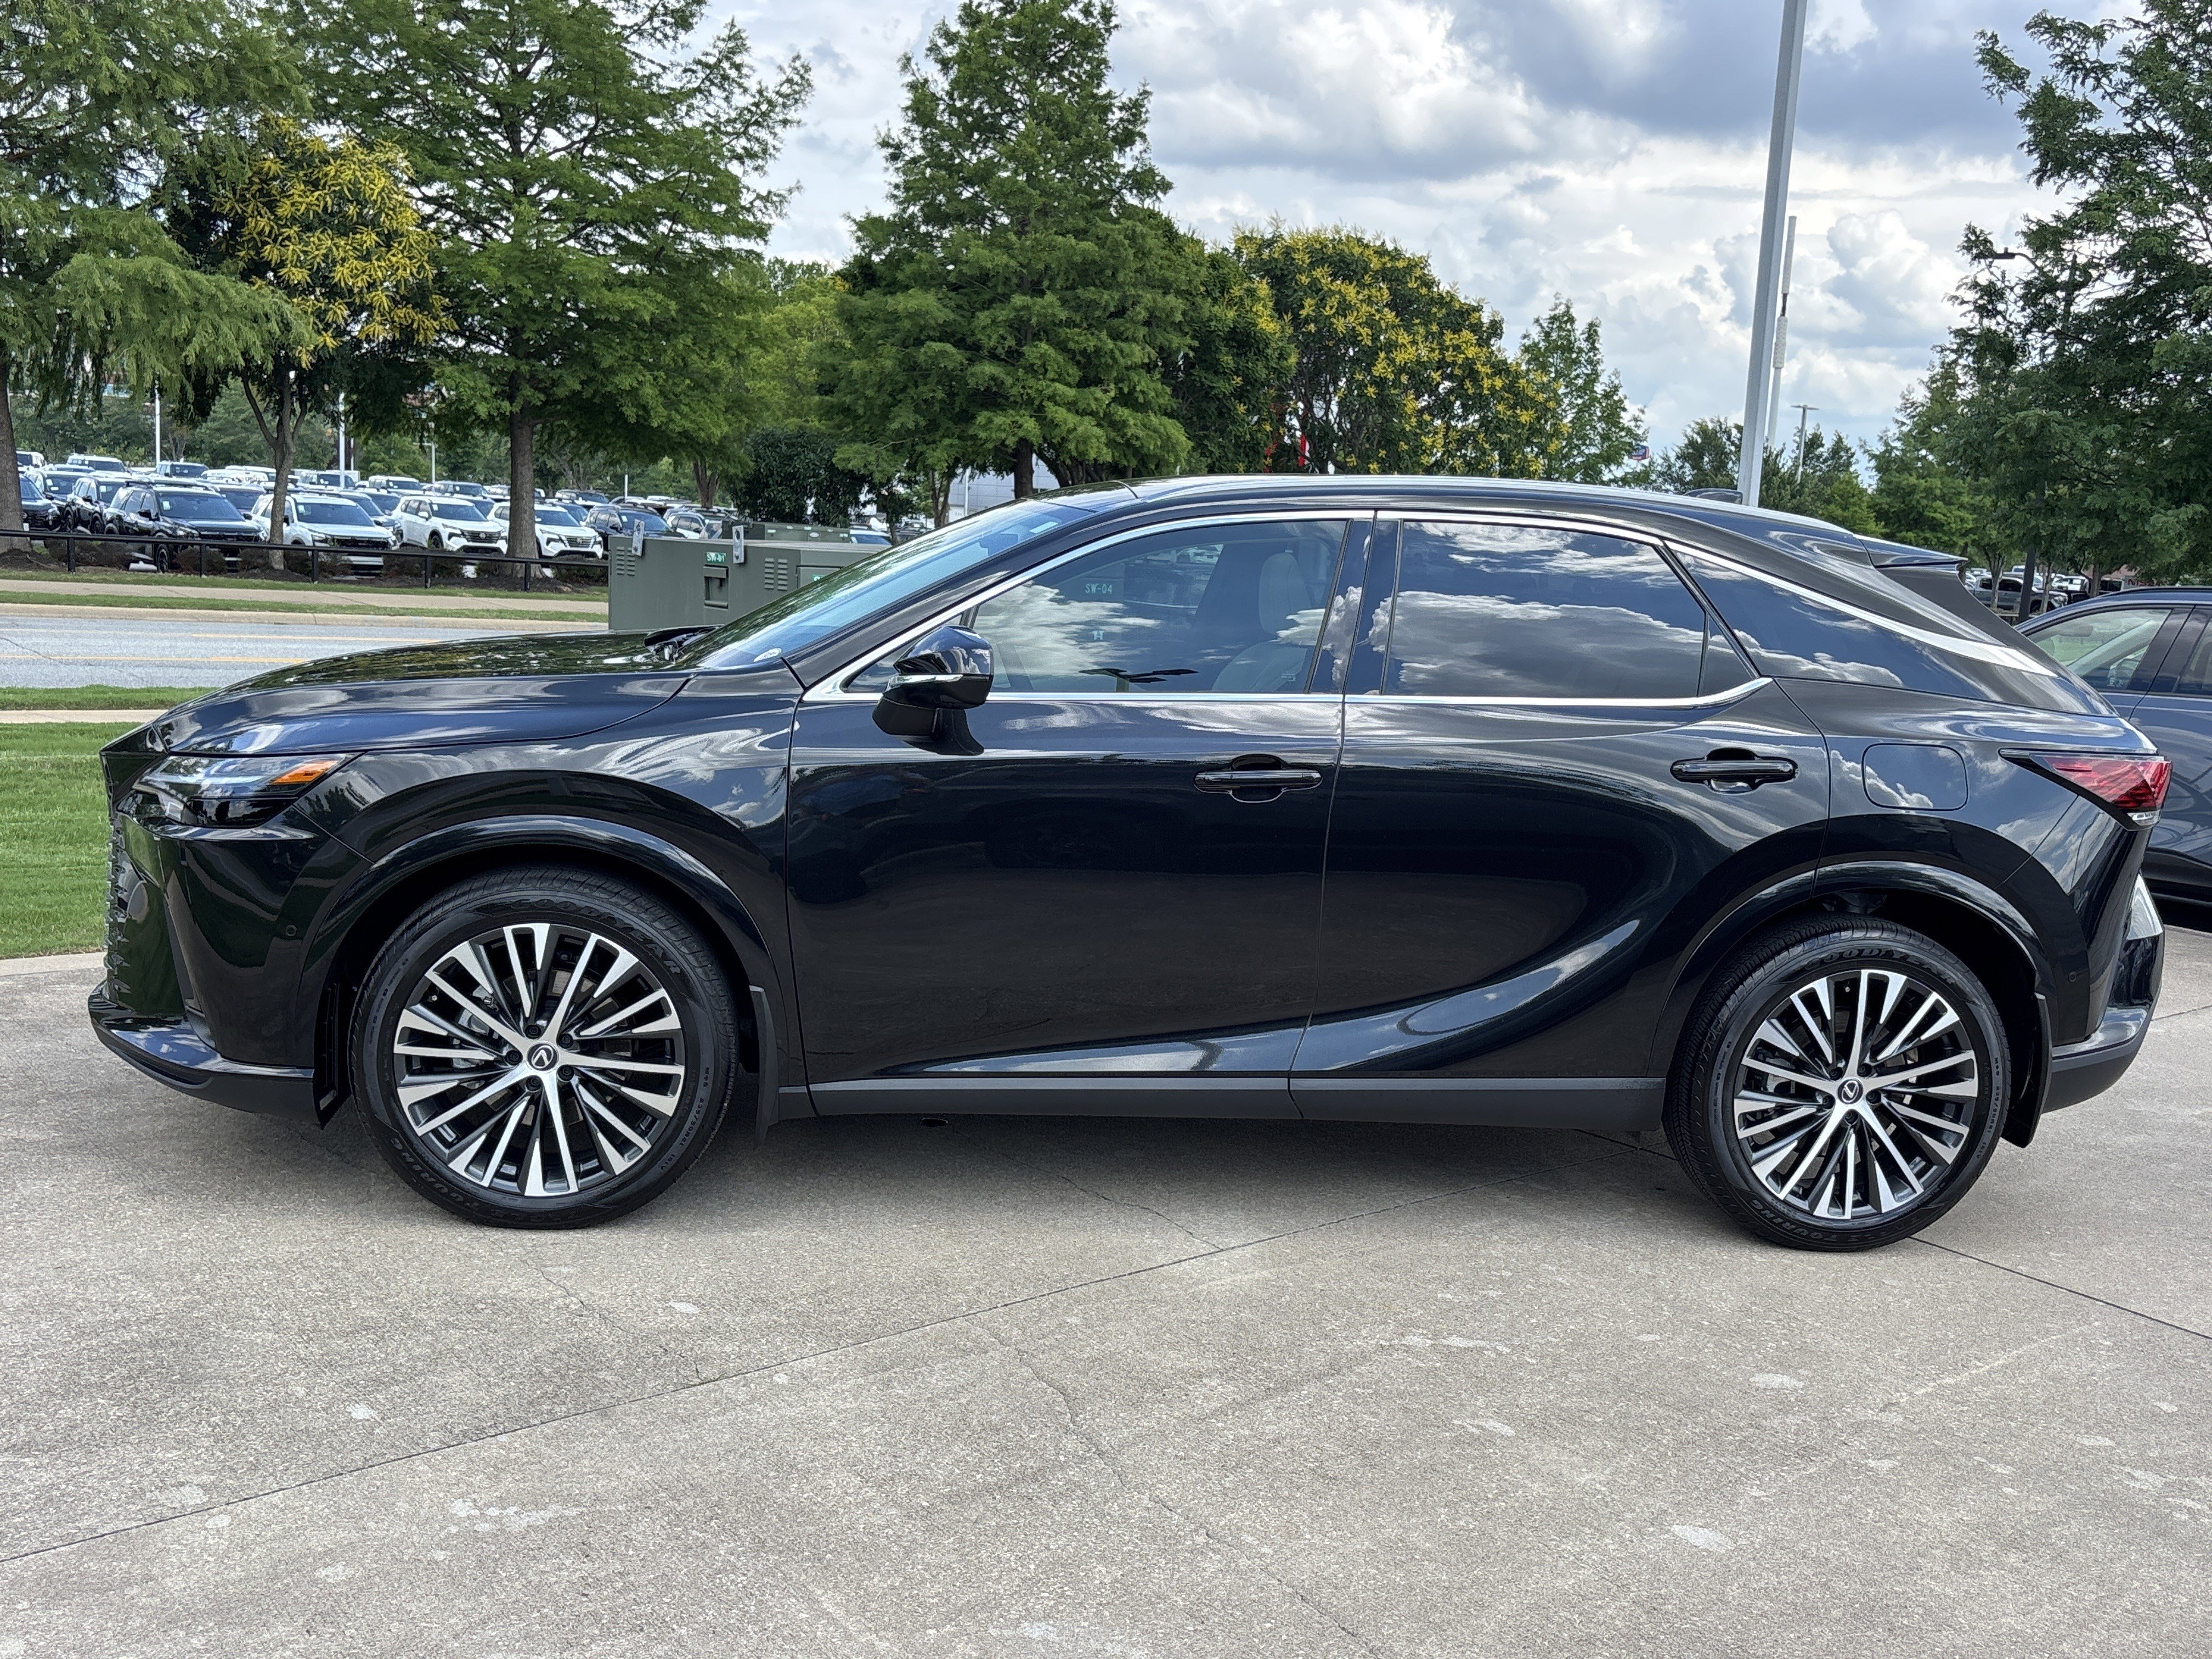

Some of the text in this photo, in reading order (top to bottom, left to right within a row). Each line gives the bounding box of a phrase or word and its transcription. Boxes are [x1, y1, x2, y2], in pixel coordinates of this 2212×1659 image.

[1086, 583, 1113, 594] SW-04
[510, 899, 681, 974] GOODYEAR
[1804, 947, 1958, 986] GOODYEAR
[391, 1137, 480, 1208] TOURING
[1751, 1199, 1839, 1242] TOURING
